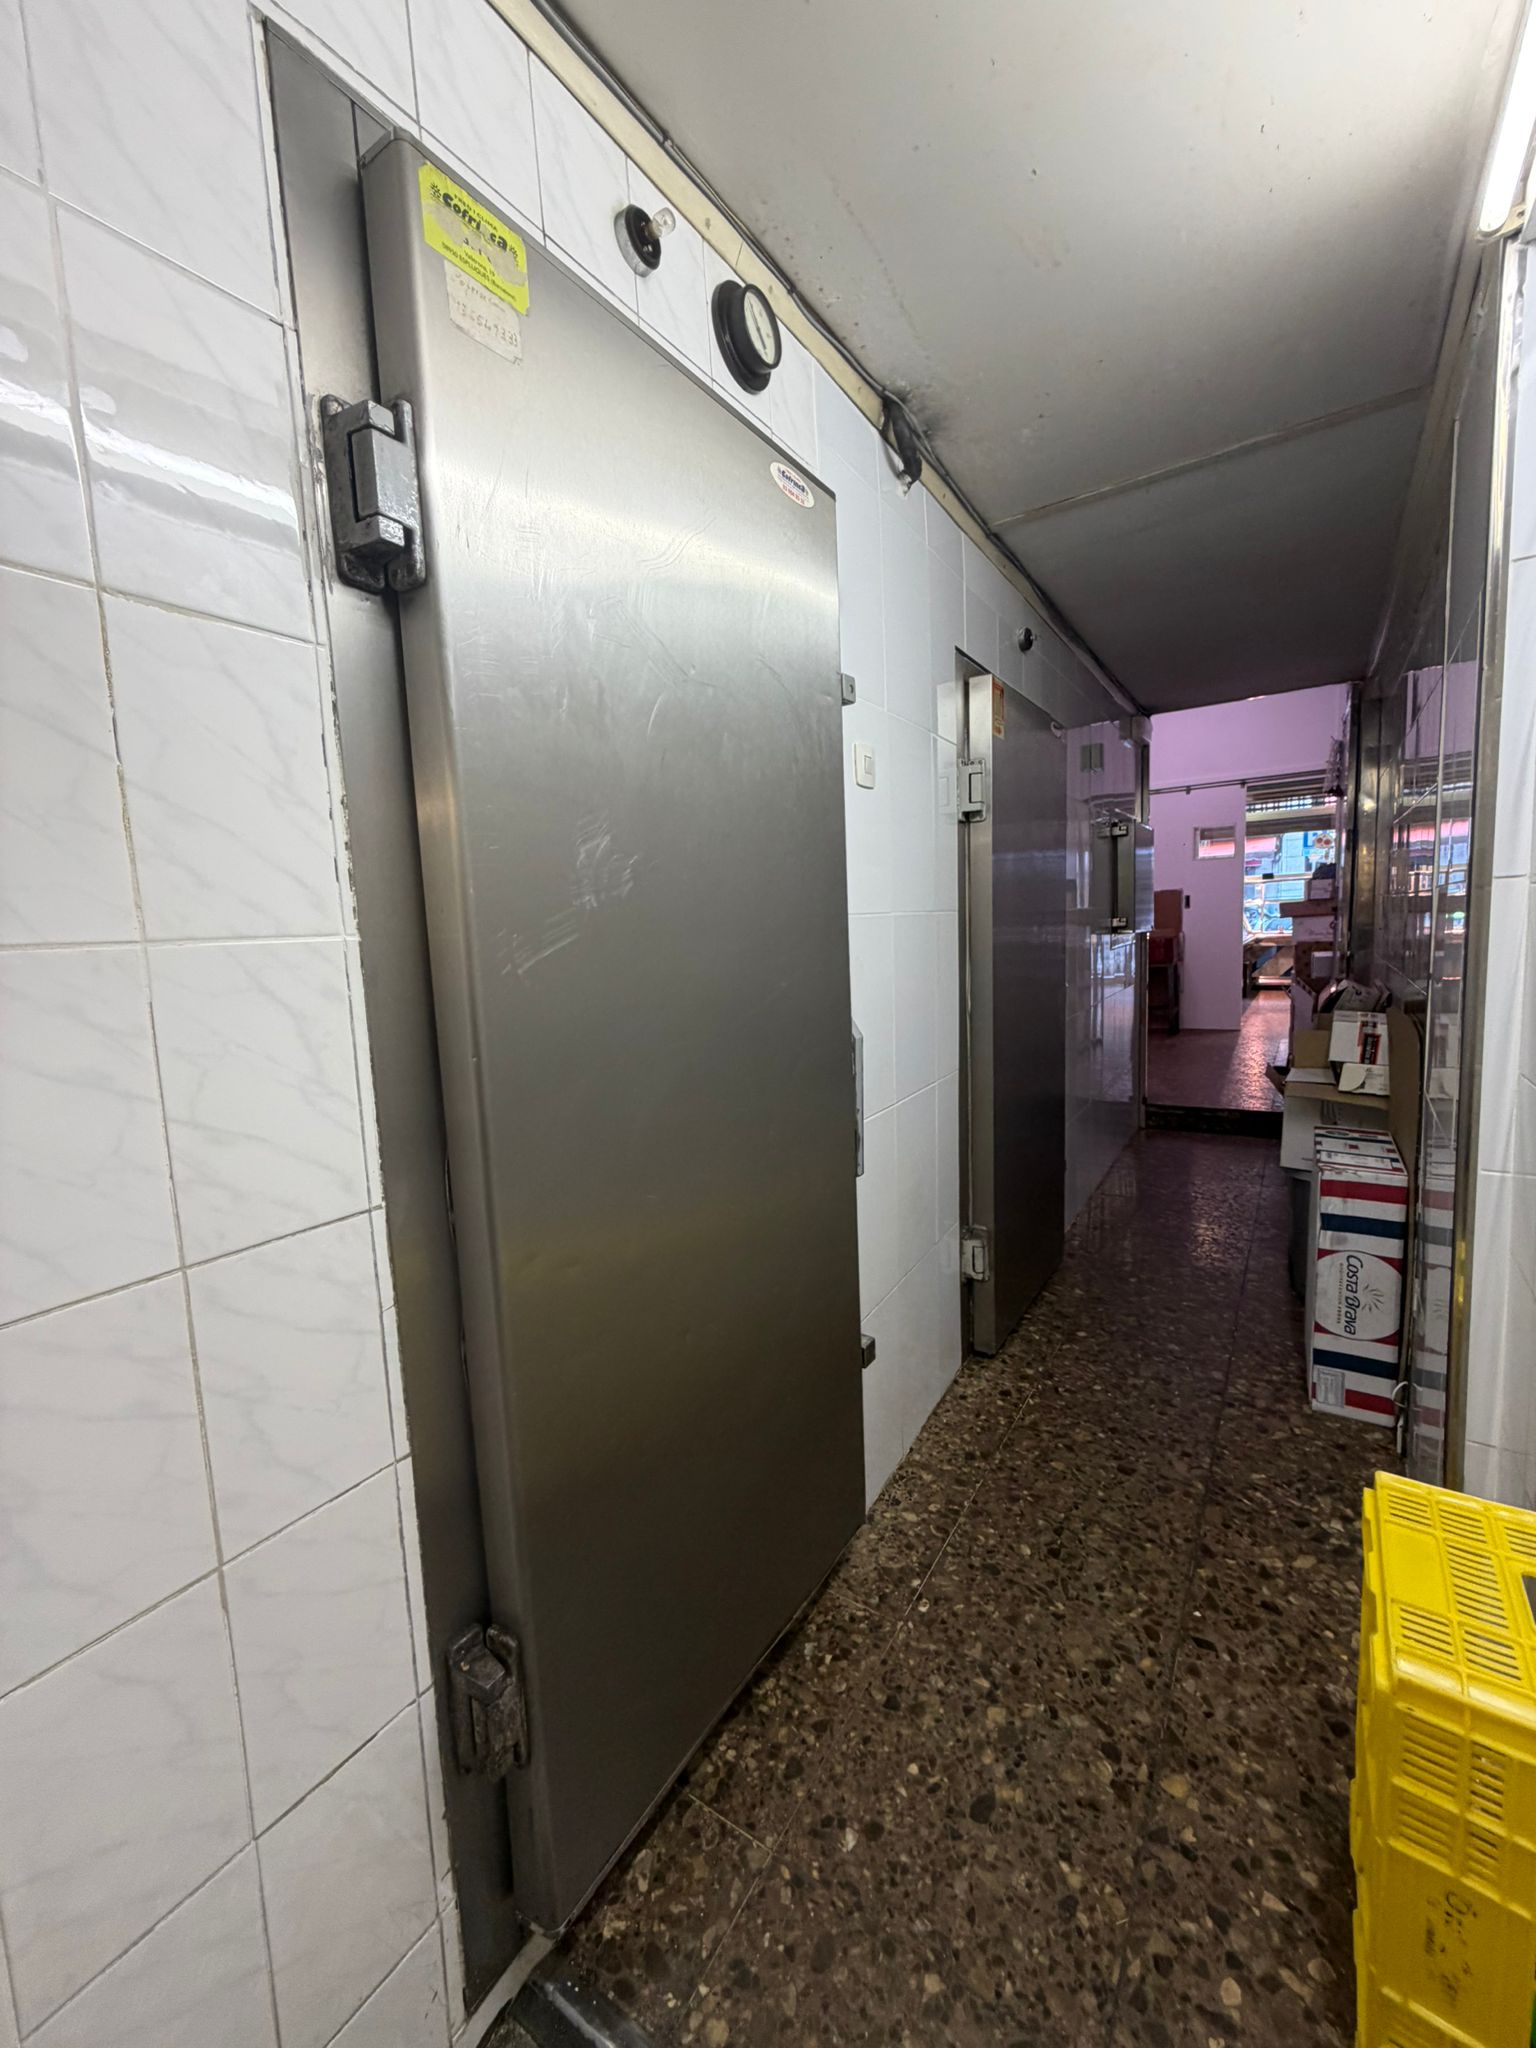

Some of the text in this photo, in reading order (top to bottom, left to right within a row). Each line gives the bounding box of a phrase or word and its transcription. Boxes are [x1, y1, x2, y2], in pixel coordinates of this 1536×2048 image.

[442, 192, 508, 253] Cofrica
[1344, 1255, 1363, 1336] Costa Brava
